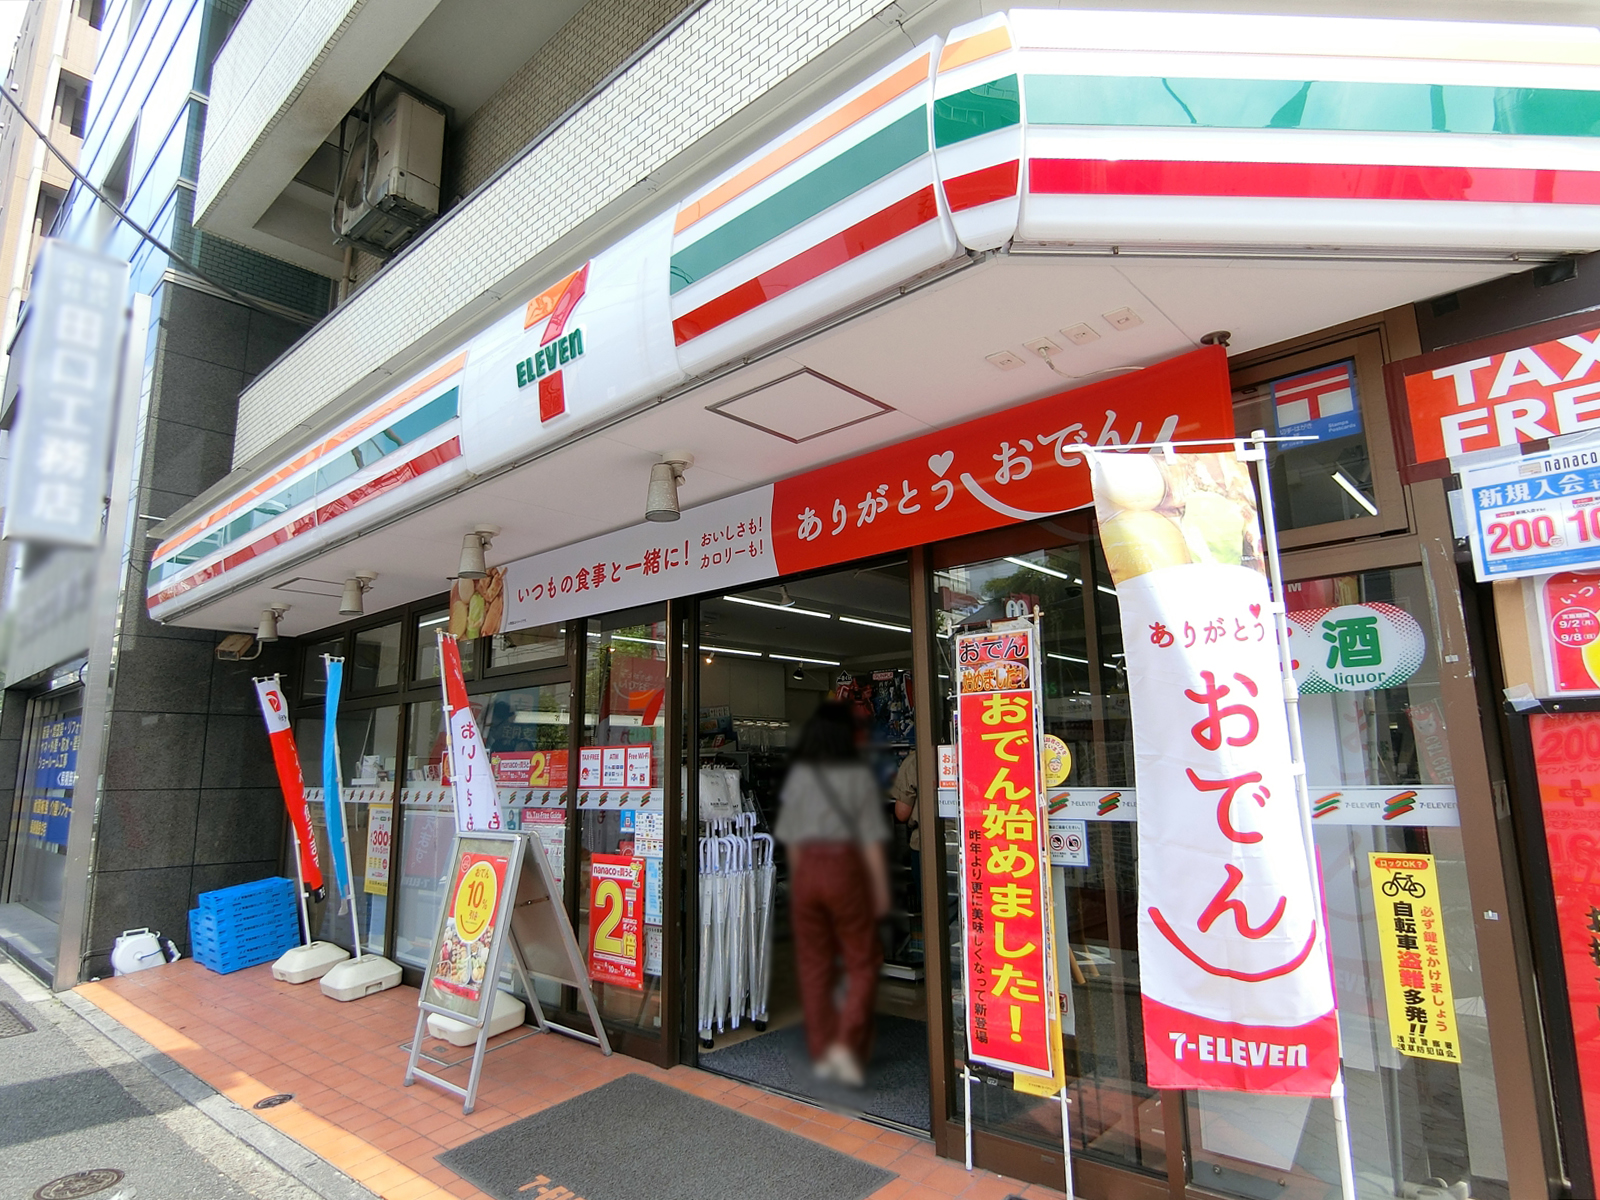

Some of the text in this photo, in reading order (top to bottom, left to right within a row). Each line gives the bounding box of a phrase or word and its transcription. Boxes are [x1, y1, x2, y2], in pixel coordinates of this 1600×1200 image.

[1544, 451, 1598, 472] nanaco
[700, 516, 763, 547] おいしさも!
[1487, 515, 1555, 555] 200
[700, 539, 764, 569] カロリーも!
[960, 638, 1026, 663] おでん
[1322, 616, 1382, 669] 酒
[1333, 671, 1386, 686] liquor
[1184, 669, 1287, 939] おでん
[981, 694, 1040, 1043] おでん始めました!
[622, 931, 637, 960] 倍
[968, 829, 989, 1044] 昨年より更に美味しくなって新登場
[1420, 905, 1448, 1032] 必ず鍵をかけましょう
